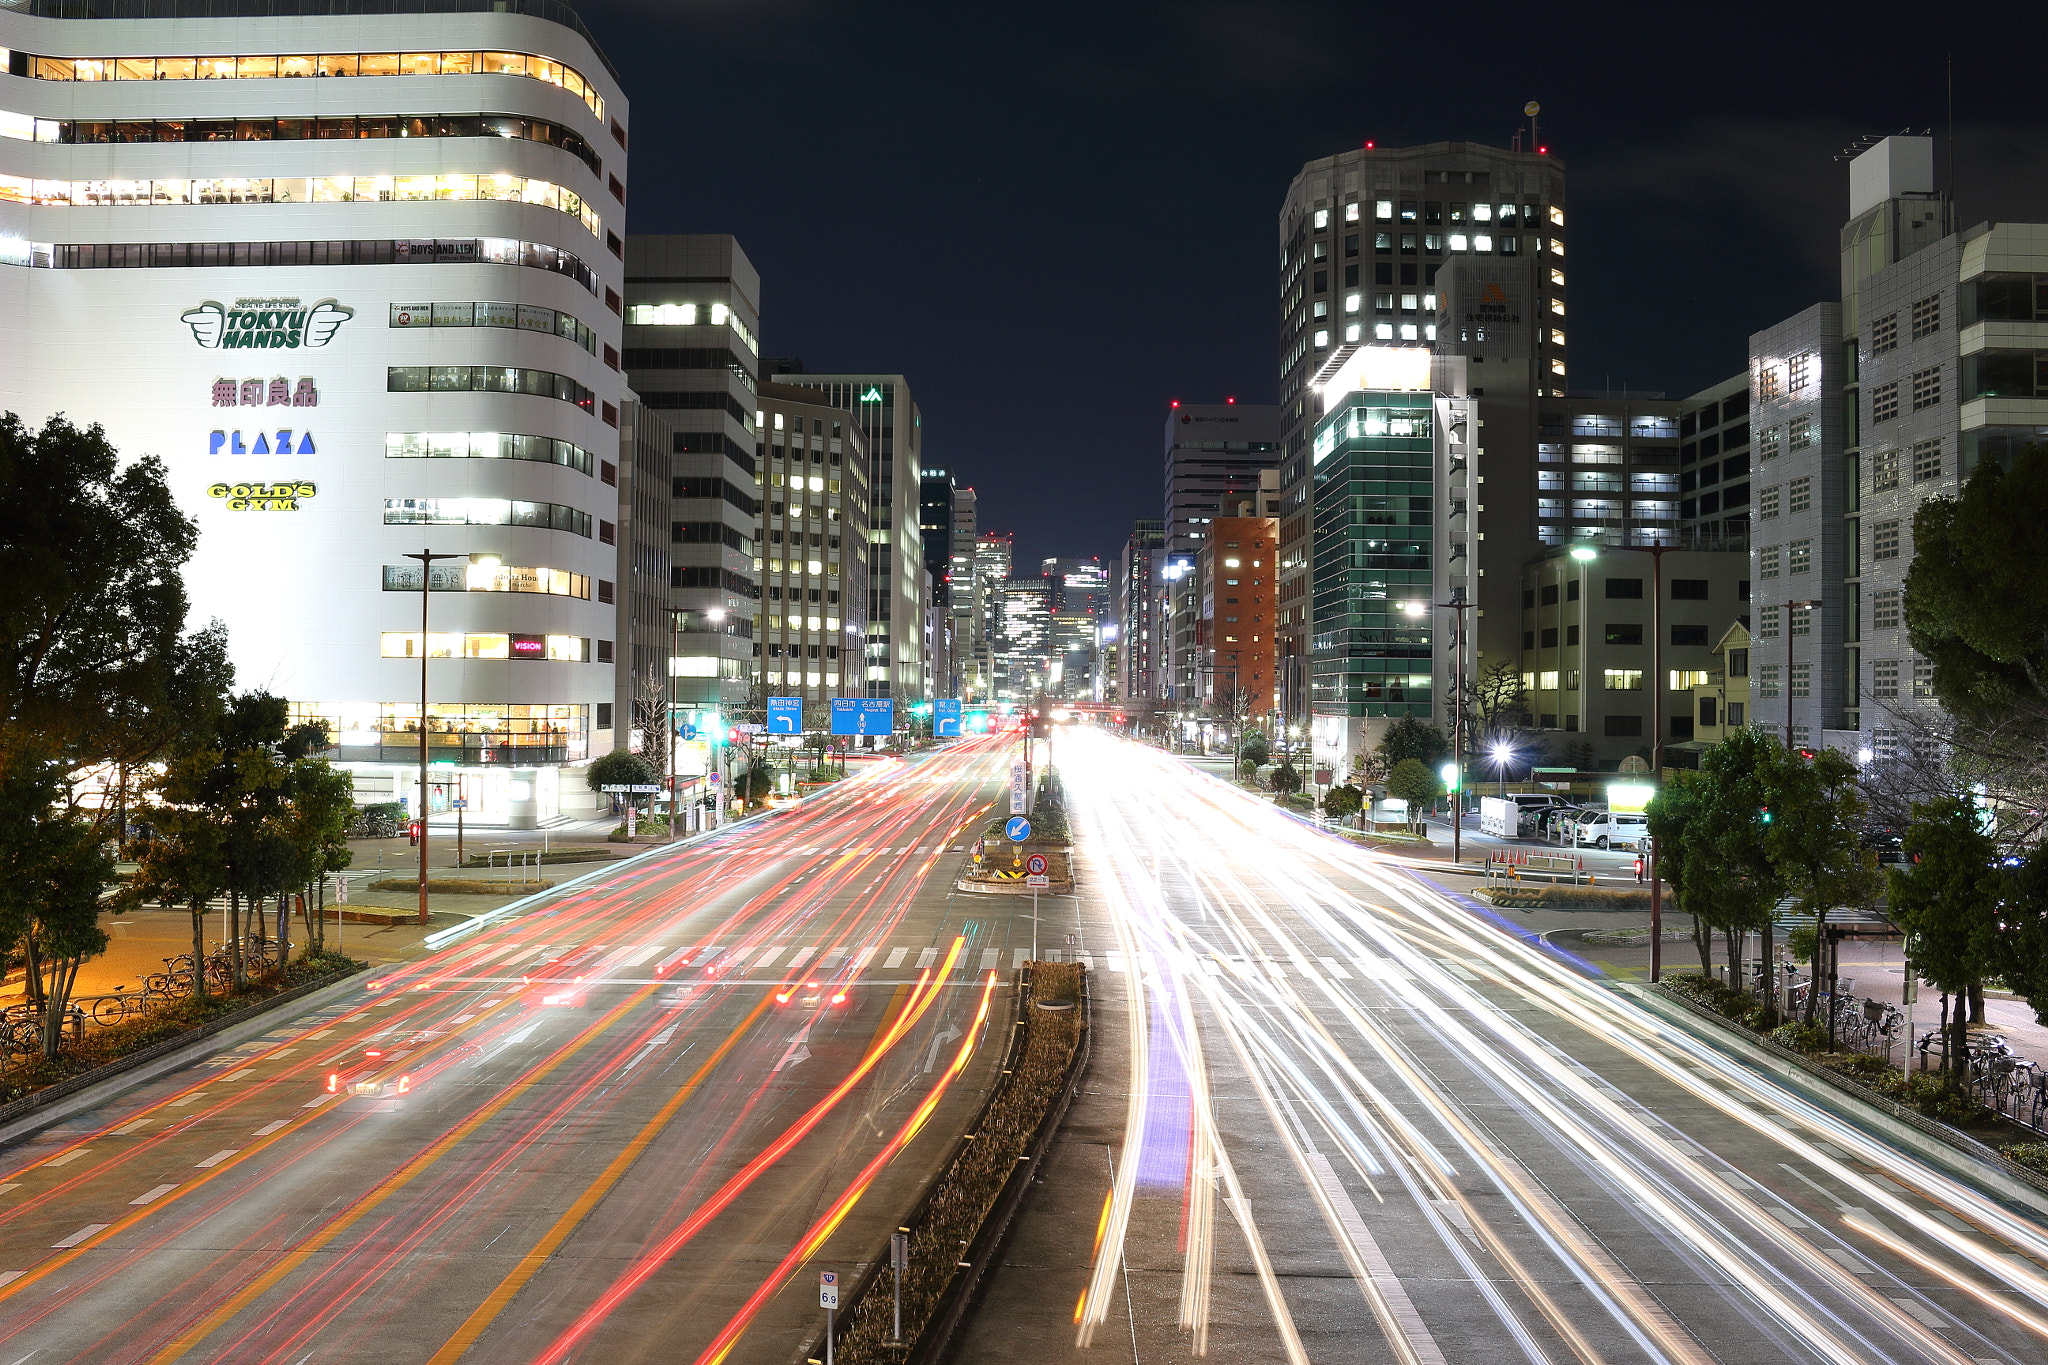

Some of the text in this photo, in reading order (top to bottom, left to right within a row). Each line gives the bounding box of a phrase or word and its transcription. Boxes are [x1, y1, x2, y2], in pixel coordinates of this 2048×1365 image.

[411, 243, 474, 255] BOYS AND MEN
[227, 311, 306, 330] TOKYU
[223, 330, 301, 349] HANDS
[211, 378, 318, 407] 無印良品
[209, 431, 316, 455] PLAZA
[207, 483, 316, 499] GOLD'S
[226, 498, 297, 512] GYM
[514, 641, 542, 651] VISION
[834, 700, 891, 708] 四日市 名古屋駅
[1013, 764, 1023, 811] 桜通久屋西
[822, 1292, 836, 1304] 6.9
